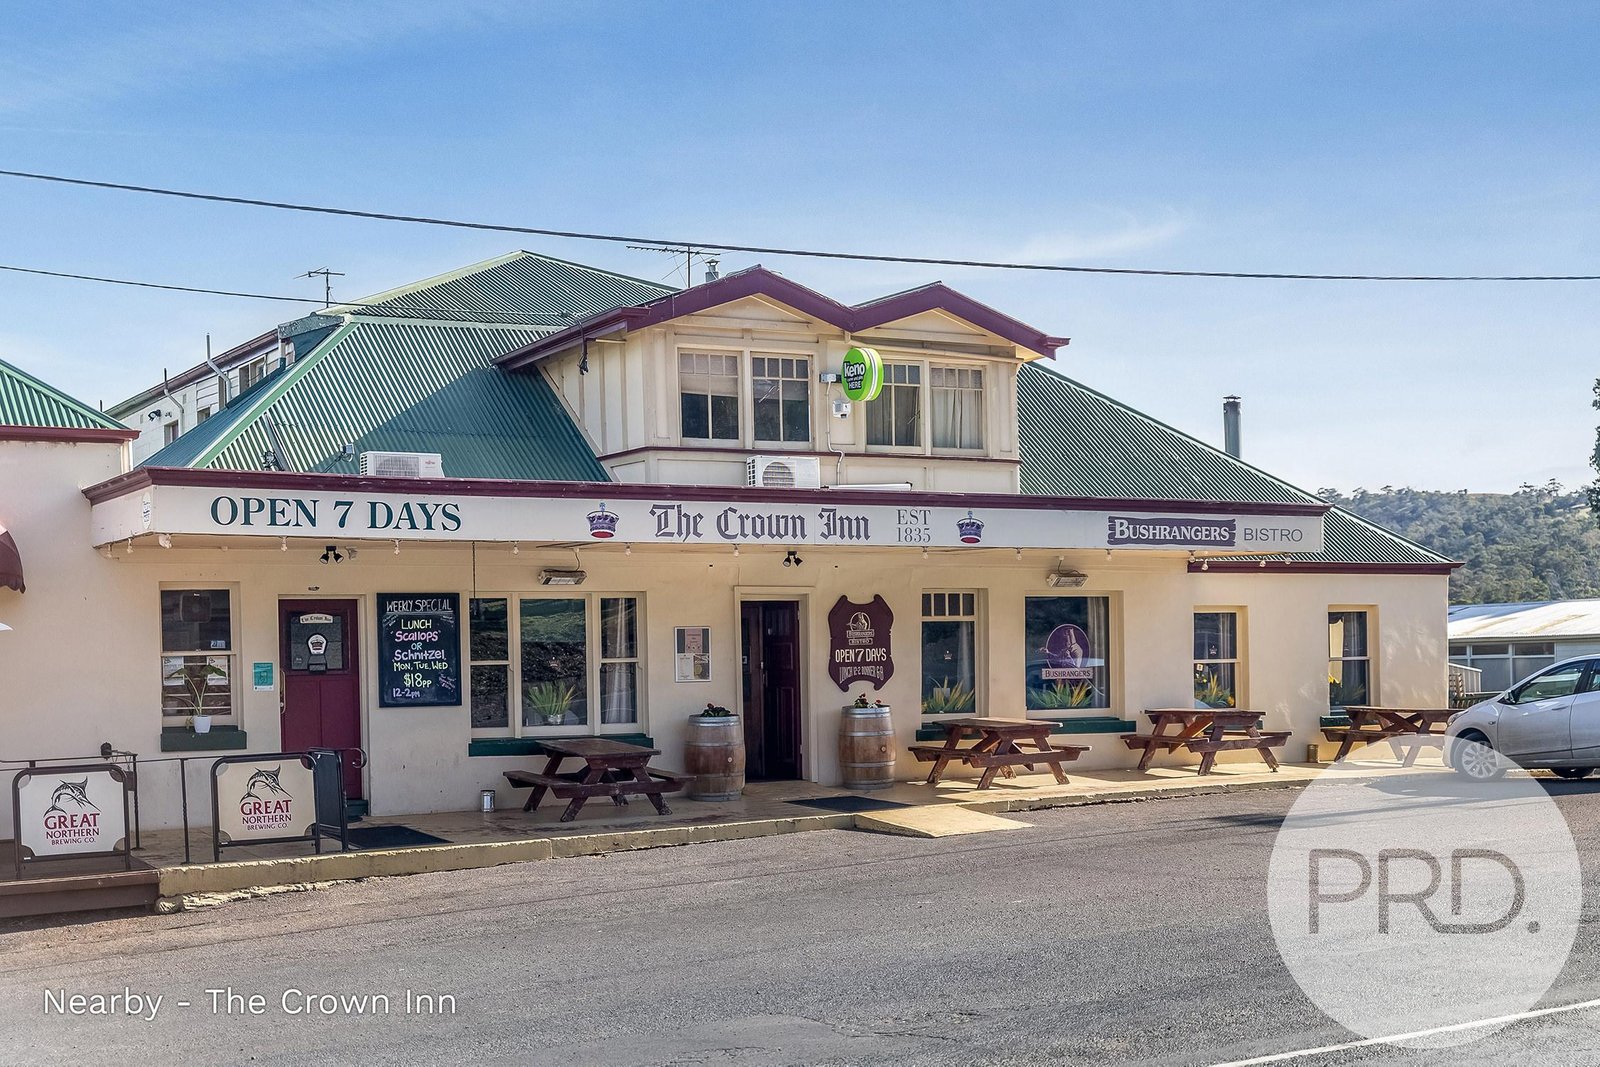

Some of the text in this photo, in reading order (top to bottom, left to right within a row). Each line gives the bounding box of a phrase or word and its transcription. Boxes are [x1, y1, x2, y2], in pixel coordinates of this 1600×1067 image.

[844, 362, 865, 377] keno
[848, 381, 861, 389] HERE
[210, 496, 462, 531] OPEN 7 DAYS
[897, 509, 932, 525] EST
[649, 504, 870, 542] The Crown Inn
[897, 527, 931, 543] 1835
[1114, 519, 1303, 542] BUSHRANGERS BISTRO
[386, 599, 452, 612] WEEKLY SPECIAL
[401, 619, 432, 630] LUNCH
[411, 642, 423, 650] OR
[835, 648, 887, 662] OPEN 7 DAYS
[431, 661, 448, 670] WED
[1045, 670, 1091, 678] BUSHRANGERS
[240, 799, 292, 816] GREAT
[44, 813, 100, 830] GREAT
[242, 814, 292, 826] NORTHERN
[45, 827, 100, 840] NORTHERN
[51, 838, 82, 846] BREWING
